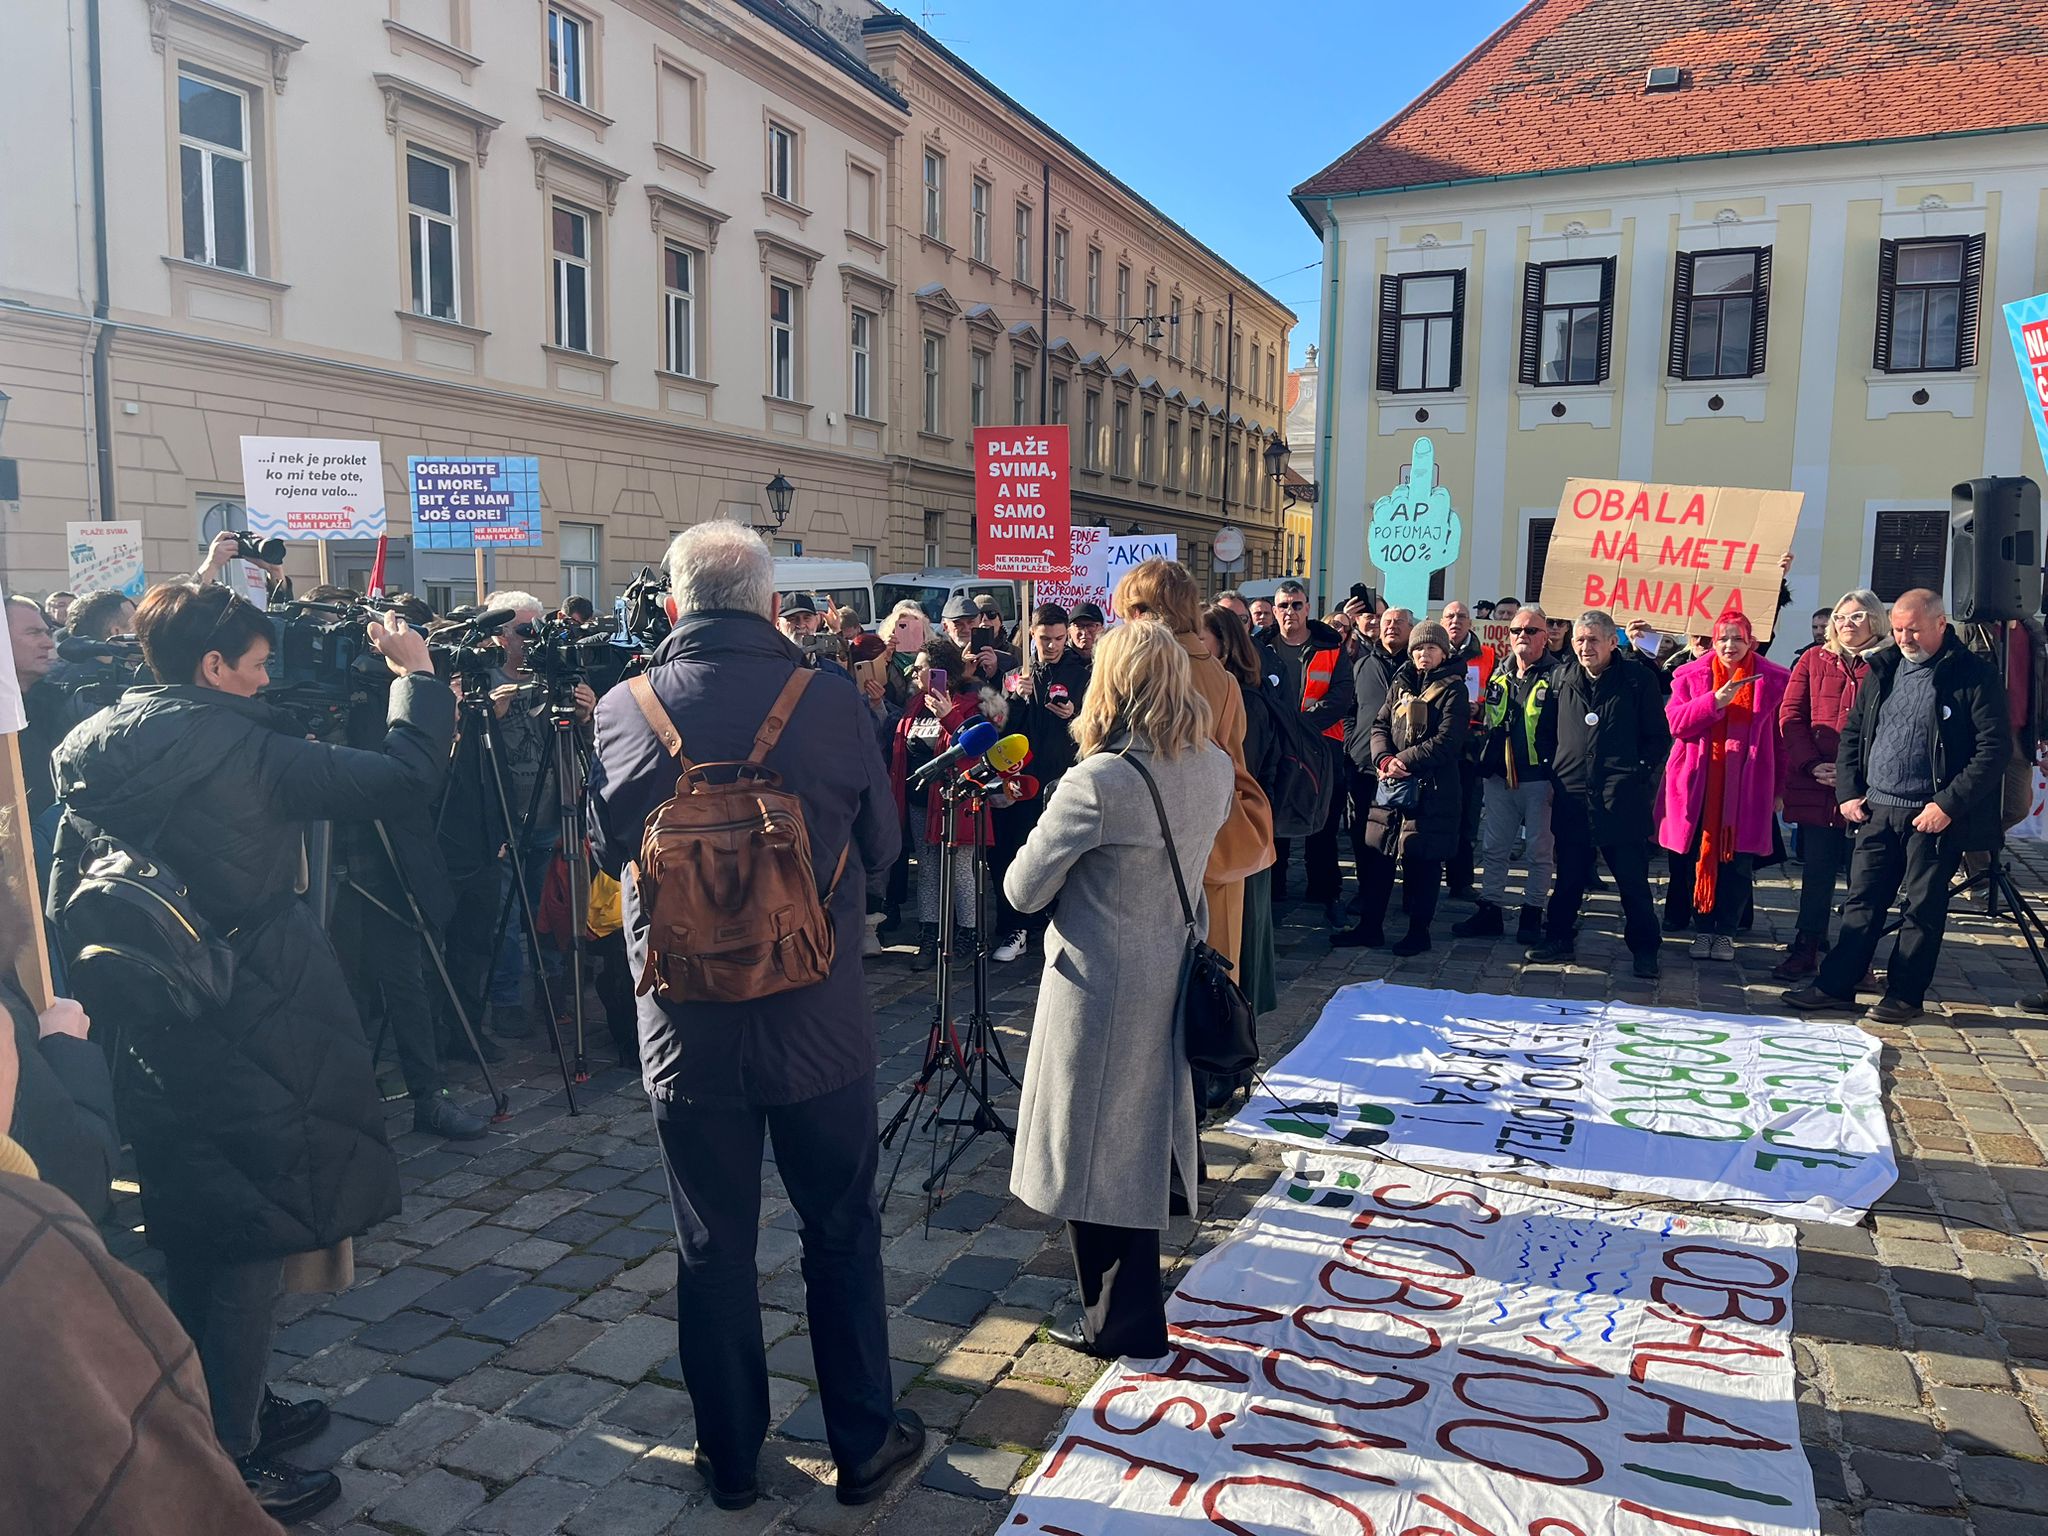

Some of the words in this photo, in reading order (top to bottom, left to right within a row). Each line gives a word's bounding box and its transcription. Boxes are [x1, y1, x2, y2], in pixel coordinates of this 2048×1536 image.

[988, 435, 1049, 456] PLAŽE
[279, 453, 304, 464] nek
[306, 453, 319, 466] je
[323, 454, 367, 466] proklet
[266, 469, 283, 480] ko
[287, 470, 304, 481] mi
[309, 470, 337, 481] tebe
[340, 472, 363, 483] ote,
[416, 463, 497, 475] OGRADITE
[989, 462, 1057, 480] SVIMA,
[275, 485, 318, 499] rojena
[322, 486, 358, 497] valo...
[418, 479, 433, 490] LI
[437, 479, 488, 492] MORE,
[998, 483, 1010, 498] A
[1016, 483, 1040, 498] NE
[419, 494, 445, 505] BIT
[449, 491, 470, 505] ĆE
[474, 494, 510, 505] NAM
[420, 506, 451, 520] JOŠ
[455, 509, 501, 520] GORE!
[993, 504, 1046, 518] SAMO
[1389, 502, 1429, 522] AP
[1573, 488, 1705, 526] OBALA
[319, 519, 351, 529] PLAŽE!
[989, 524, 1055, 539] NJIMA!
[80, 528, 105, 536] PLAŽE
[105, 528, 129, 536] SVIMA
[499, 532, 526, 540] PLAŽE!
[1380, 543, 1432, 563] 100%
[1590, 530, 1638, 563] NA
[1658, 535, 1760, 574] METI
[1021, 563, 1050, 571] PLAŽE!
[1093, 586, 1106, 596] SE
[1583, 574, 1744, 620] BANAKA
[1520, 1052, 1589, 1092] DIO
[1609, 1022, 1756, 1142] DOBRO
[1487, 1093, 1577, 1171] HOTELA
[1753, 1127, 1868, 1172] JE
[1624, 1244, 1793, 1452] OBALA
[1202, 1183, 1502, 1536] SLOBODNO
[1620, 1462, 1793, 1506] I
